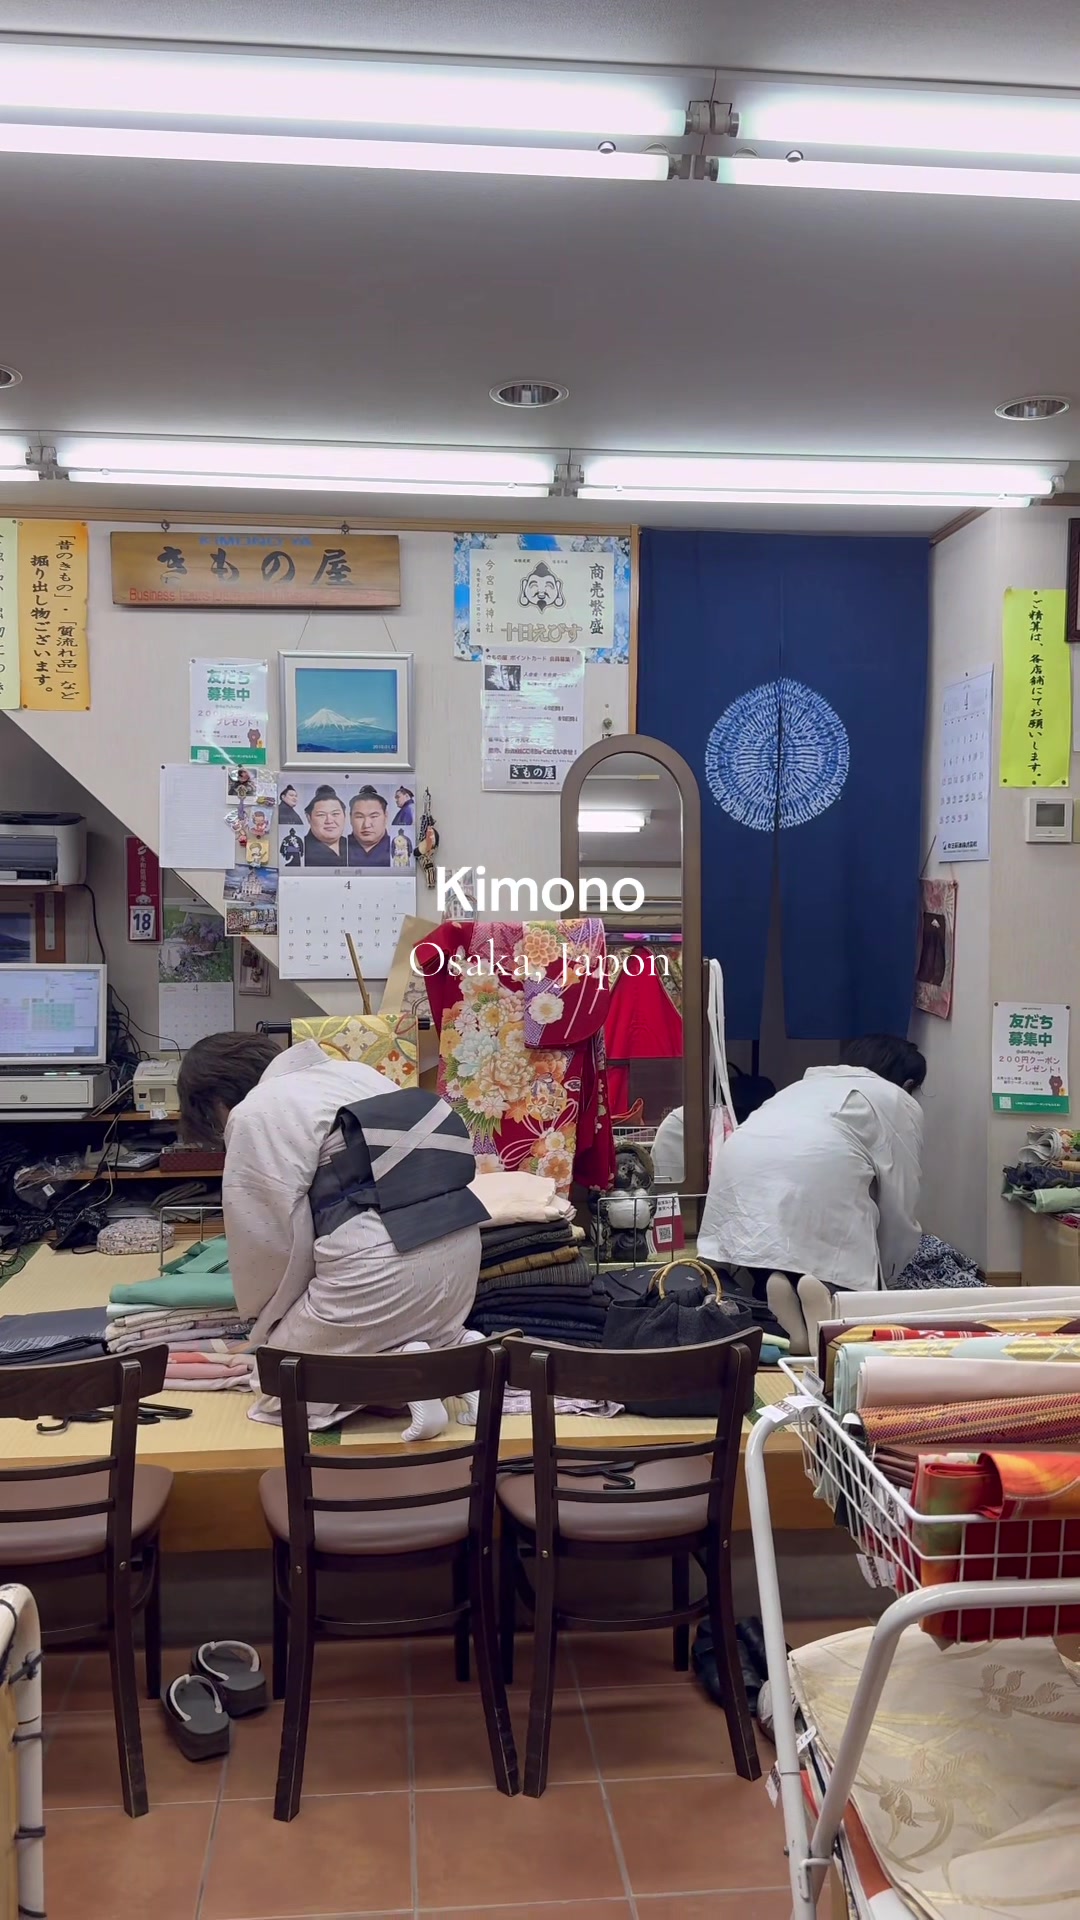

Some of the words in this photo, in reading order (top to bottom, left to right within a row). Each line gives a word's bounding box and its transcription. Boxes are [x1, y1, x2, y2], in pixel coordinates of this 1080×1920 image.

[157, 546, 355, 586] きもの屋
[129, 588, 175, 602] Business
[588, 562, 606, 635] 商売繁盛
[30, 554, 54, 693] 掘り出し物ございます。
[501, 622, 583, 644] 十日えびす
[207, 687, 251, 702] 募集中
[511, 766, 556, 779] きもの屋
[344, 880, 351, 890] 4
[133, 913, 151, 931] 18
[193, 984, 198, 992] 4
[1009, 1013, 1053, 1030] 友だち
[1008, 1031, 1052, 1047] 募集中
[1017, 1064, 1060, 1073] プレゼント！
